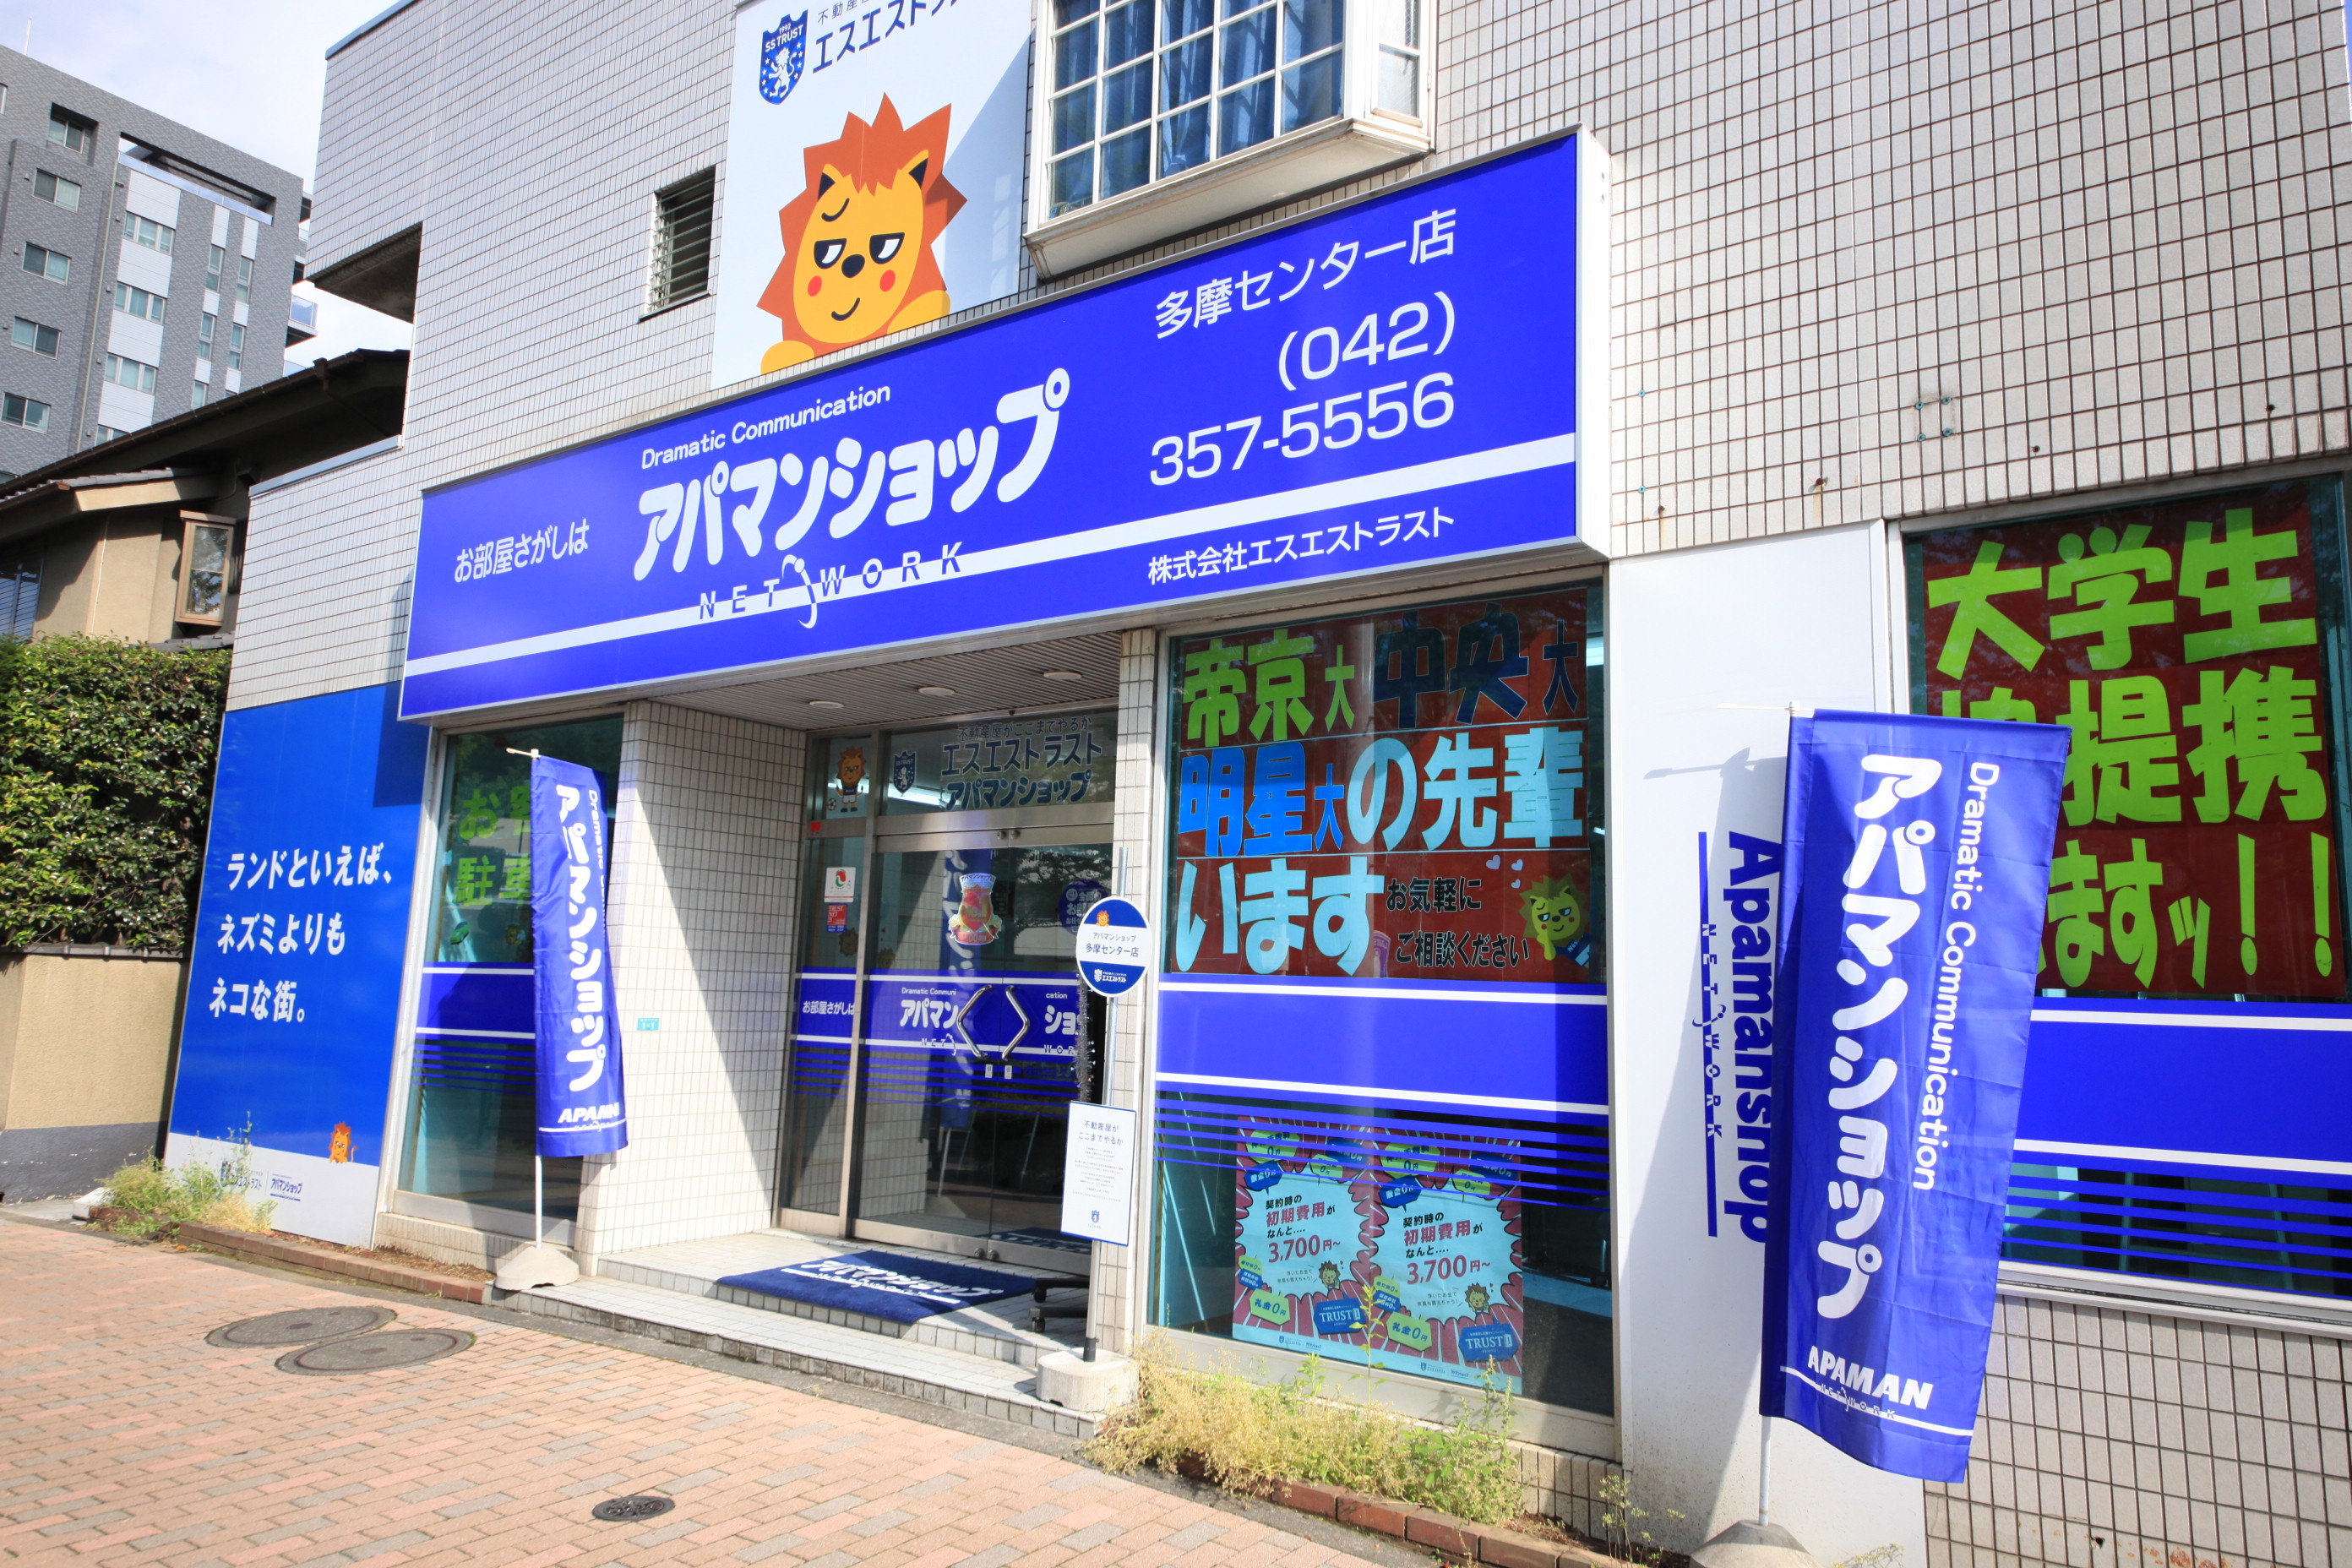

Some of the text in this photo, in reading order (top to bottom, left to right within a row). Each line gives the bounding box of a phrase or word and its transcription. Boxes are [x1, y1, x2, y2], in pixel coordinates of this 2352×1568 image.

[817, 0, 868, 25] 不動産
[1155, 208, 1456, 339] 多摩センター店
[1278, 291, 1456, 391] (042)
[641, 382, 891, 471] Dramatic Communication
[1150, 372, 1455, 487] 357-5556
[634, 368, 1070, 581] アパマンショップ
[454, 517, 590, 582] お部屋さがしは
[1147, 506, 1455, 585] 株式会社エスエストラスト
[1926, 508, 2318, 681] 大学生
[958, 716, 1093, 741] 不動産屋がここまでやるか
[940, 731, 1102, 776] エスエストラスト
[945, 769, 1093, 811] アパマンショップ
[226, 841, 392, 891] ランドといえば、
[1175, 855, 1386, 977] います
[1386, 876, 1482, 913] お気軽に
[216, 912, 346, 956] ネズミよりも
[556, 784, 607, 1092] アパマンショップ
[1086, 943, 1139, 957] 多摩センター店
[1092, 932, 1137, 942] アパマンショップ
[1395, 930, 1530, 969] ご相談ください
[901, 987, 928, 995] Dramatic
[1911, 760, 2001, 1192] Dramatic Communication
[209, 977, 305, 1023] ネコな街。
[900, 999, 960, 1029] アパマン
[1816, 754, 1942, 1320] アパマンショップ
[1078, 1132, 1124, 1146] ここまでやるか
[1084, 1119, 1119, 1132] 不動産屋が
[1266, 1195, 1303, 1210] 契約時の
[1266, 1201, 1336, 1227] 初期費用が
[1403, 1211, 1444, 1228] 契約時の
[1404, 1220, 1483, 1247] 初期費用が
[1807, 1345, 1934, 1410] APAMAN
